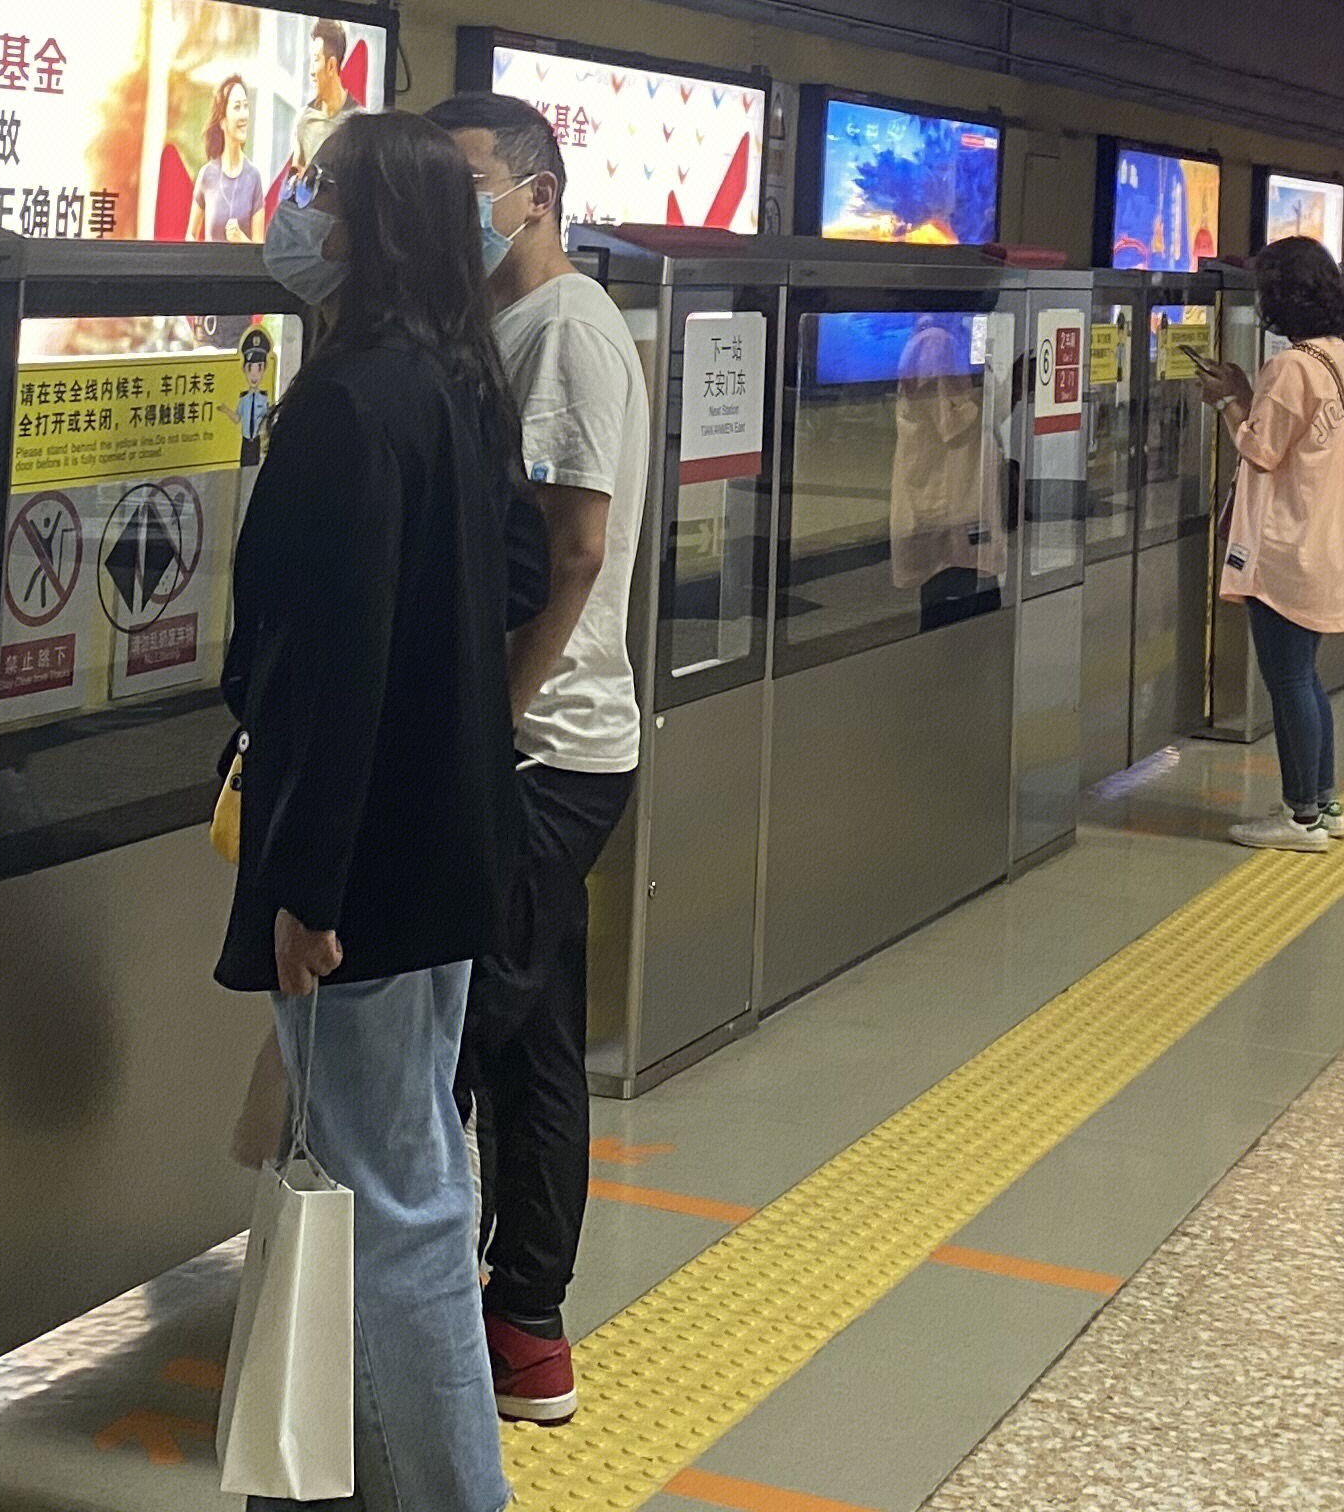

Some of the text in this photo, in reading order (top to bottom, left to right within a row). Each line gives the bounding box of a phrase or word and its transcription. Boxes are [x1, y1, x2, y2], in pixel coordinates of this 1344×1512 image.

[711, 335, 742, 362] 下一站
[704, 369, 746, 398] 天安门东
